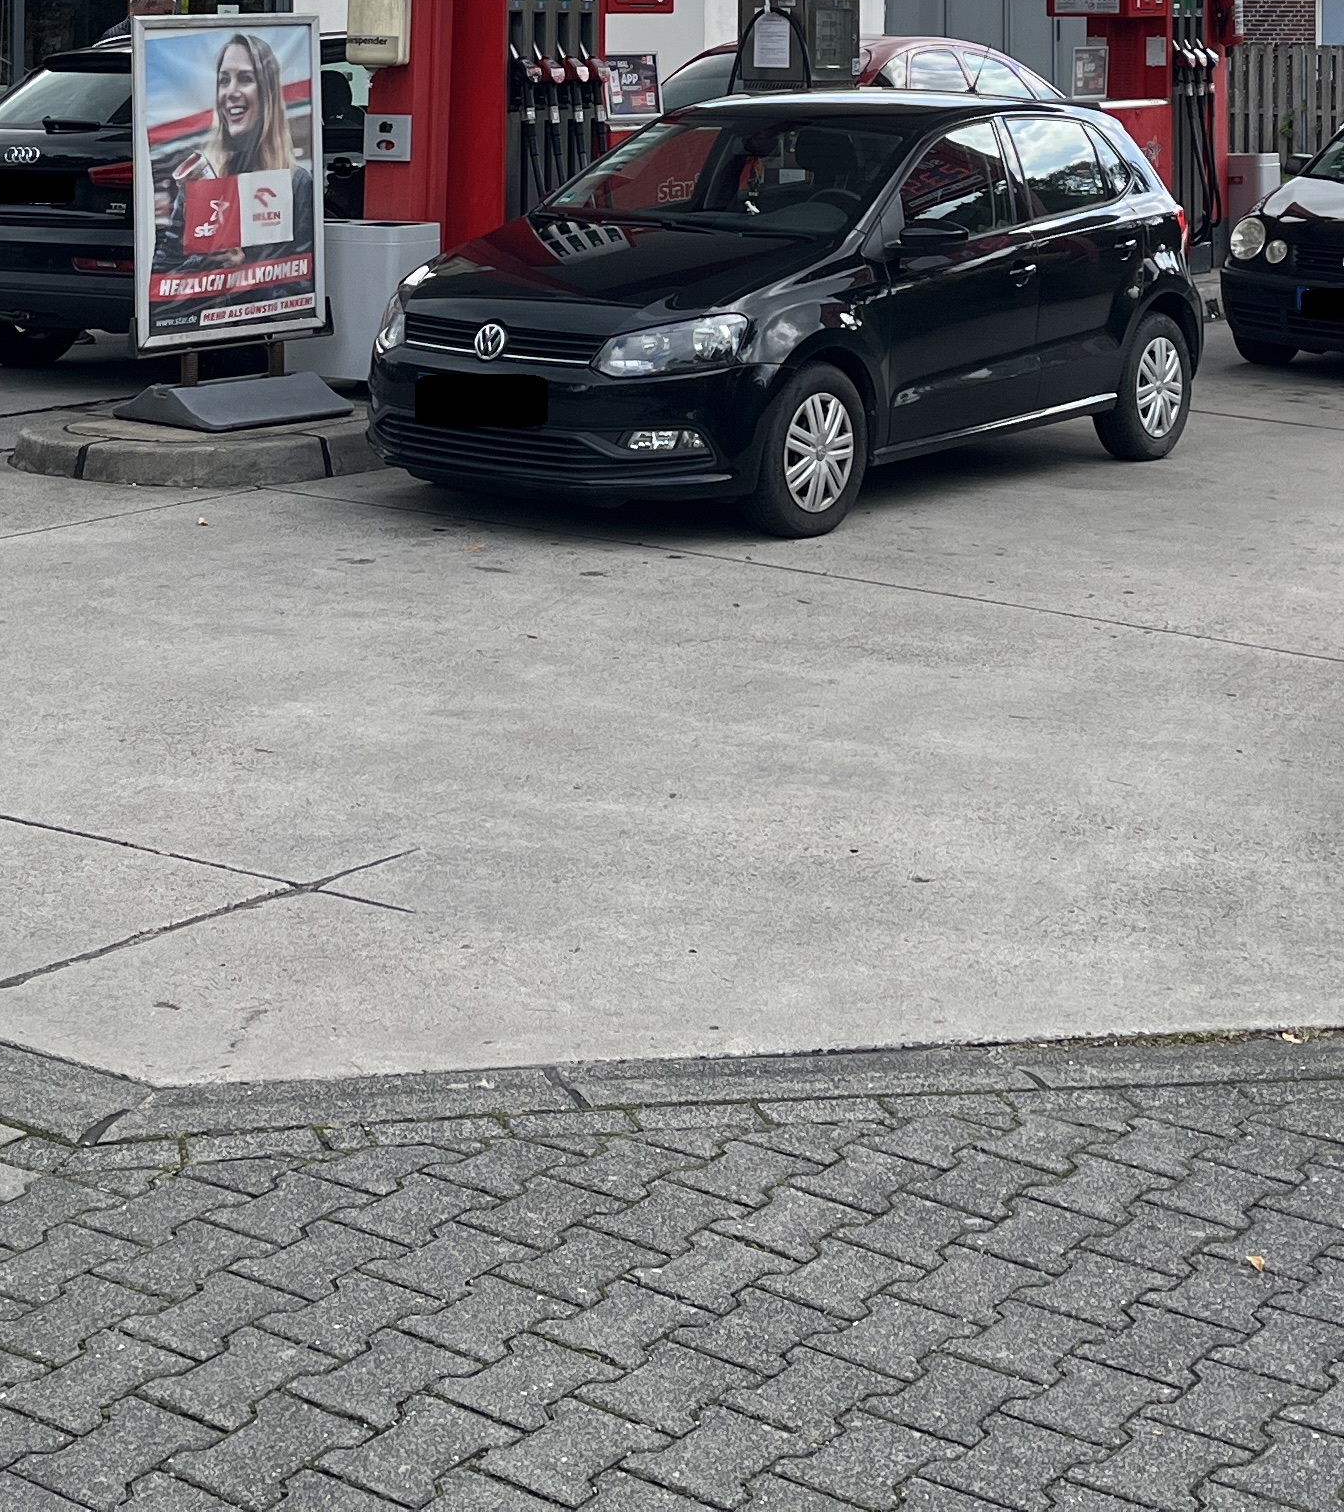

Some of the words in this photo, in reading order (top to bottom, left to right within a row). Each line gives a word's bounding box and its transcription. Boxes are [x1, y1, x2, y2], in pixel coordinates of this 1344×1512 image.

[621, 73, 639, 85] APP
[159, 274, 224, 296] HERZLICH
[226, 259, 308, 289] WILLKOMMEN
[203, 311, 227, 322] MEHR
[228, 308, 243, 318] ALS
